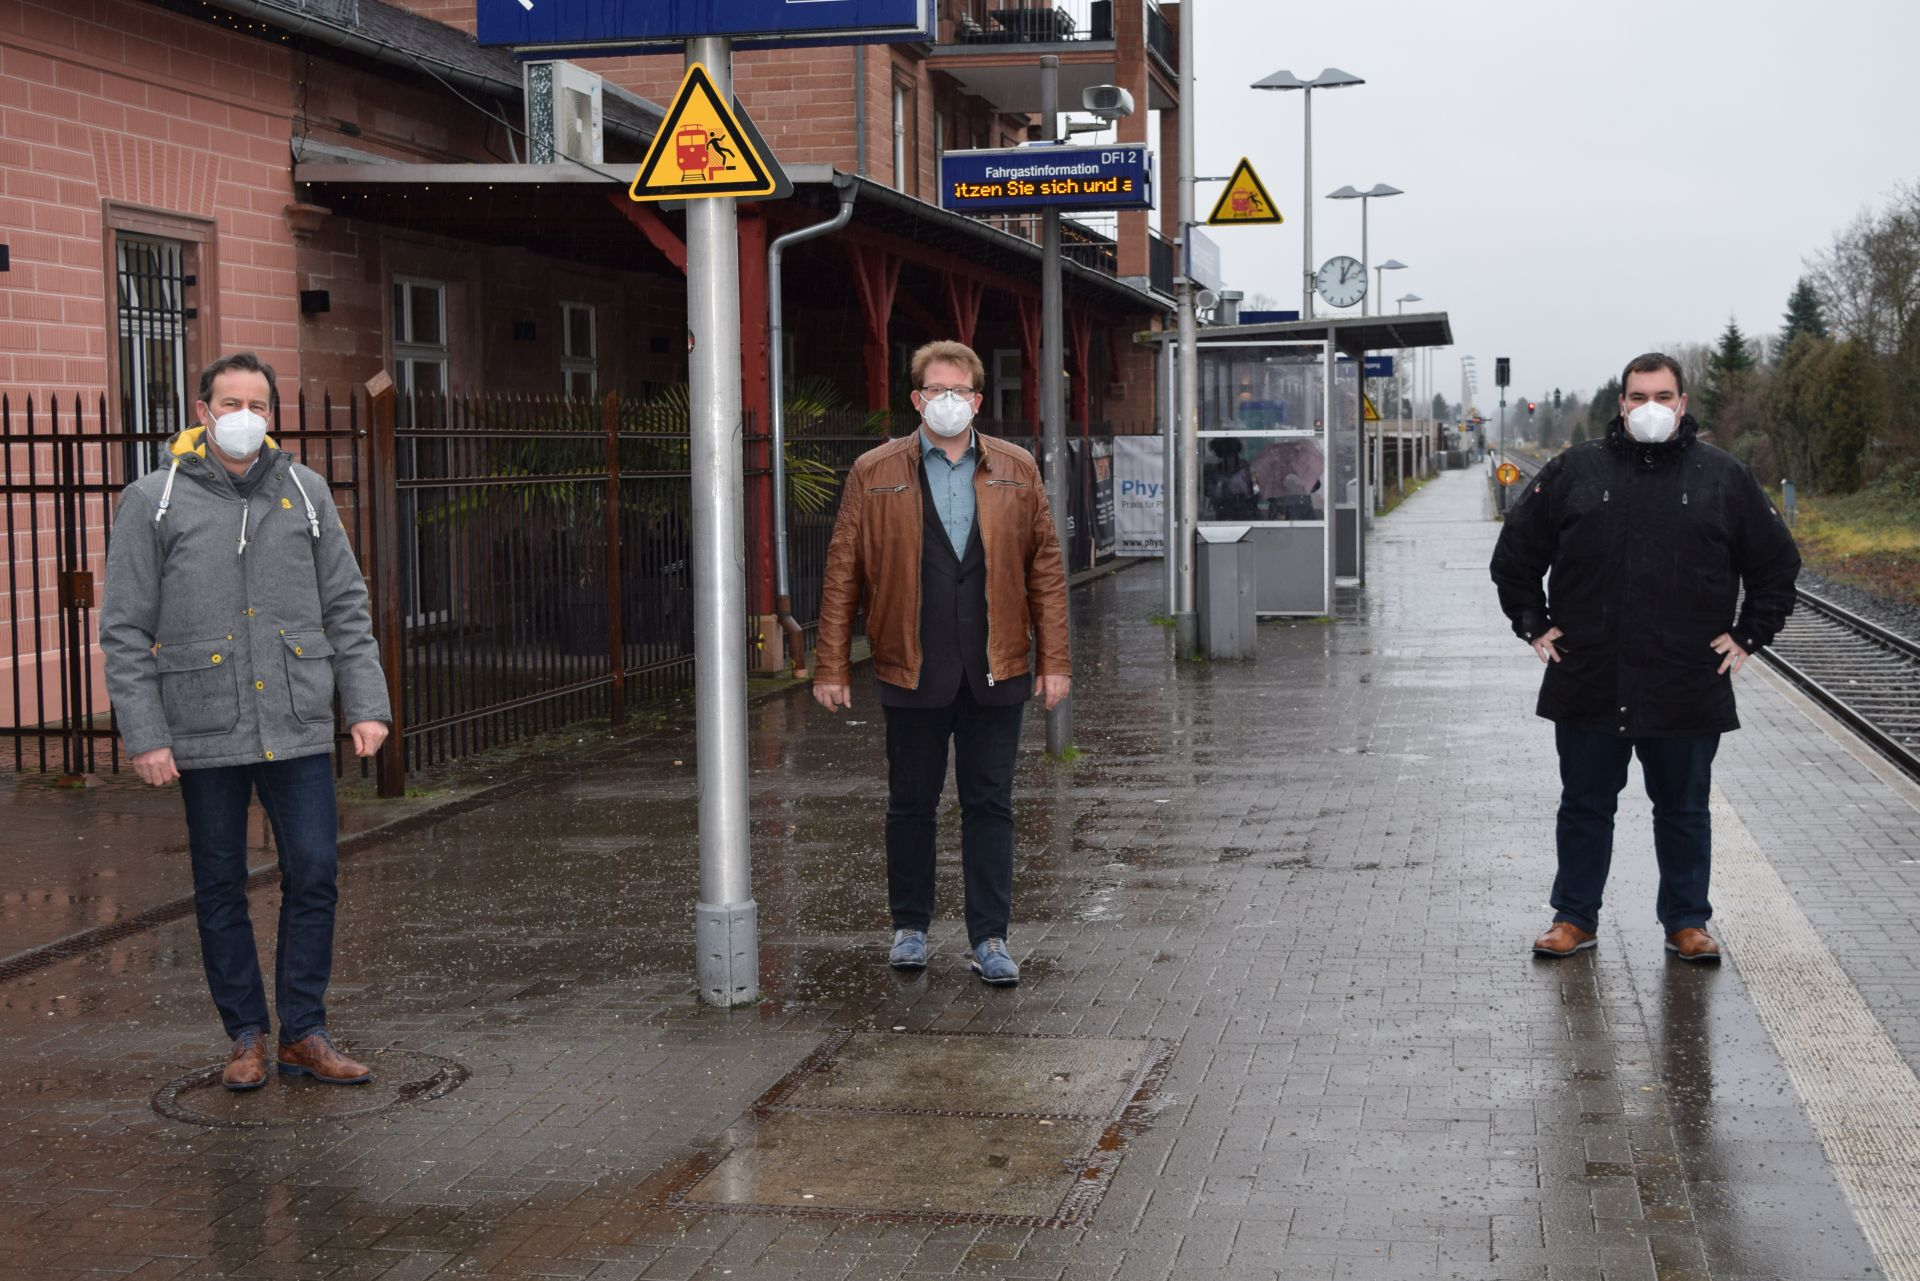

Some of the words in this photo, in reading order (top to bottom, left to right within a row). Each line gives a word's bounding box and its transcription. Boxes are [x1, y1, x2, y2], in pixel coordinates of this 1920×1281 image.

[1101, 152, 1125, 165] DFI
[1127, 151, 1137, 164] 2
[985, 163, 1100, 180] Fahrgastinformation
[1007, 180, 1035, 196] Sie
[1040, 178, 1079, 195] sich
[1083, 176, 1118, 193] und
